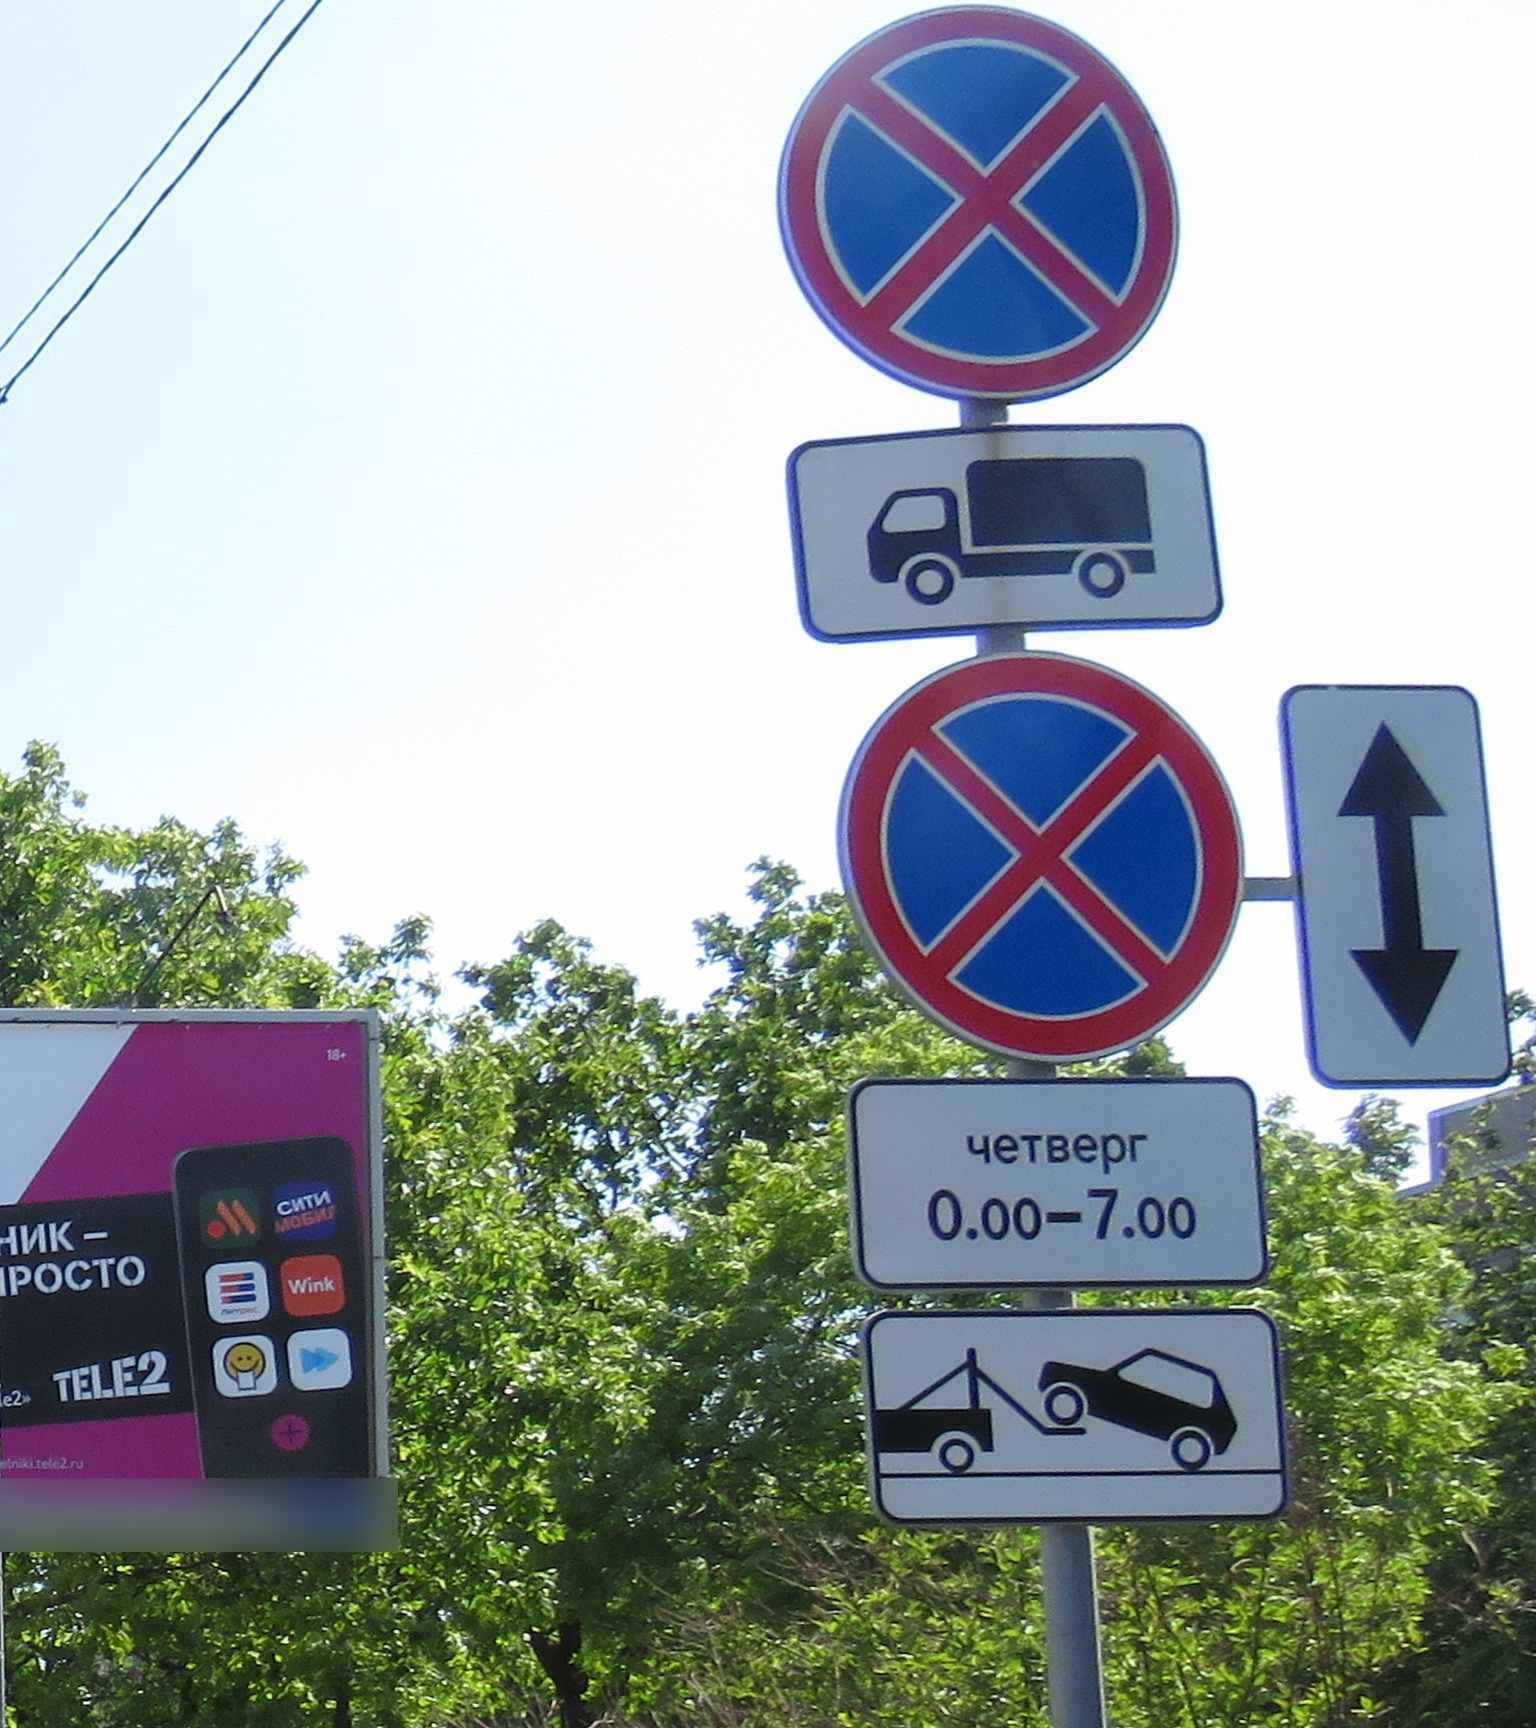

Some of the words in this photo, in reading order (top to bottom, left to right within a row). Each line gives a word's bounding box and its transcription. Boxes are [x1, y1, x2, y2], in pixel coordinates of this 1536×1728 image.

[327, 1049, 347, 1061] 18+
[966, 1133, 1147, 1173] четверг
[276, 1190, 332, 1216] СИТИ
[288, 1279, 336, 1295] Wink
[52, 1351, 170, 1404] TELE2
